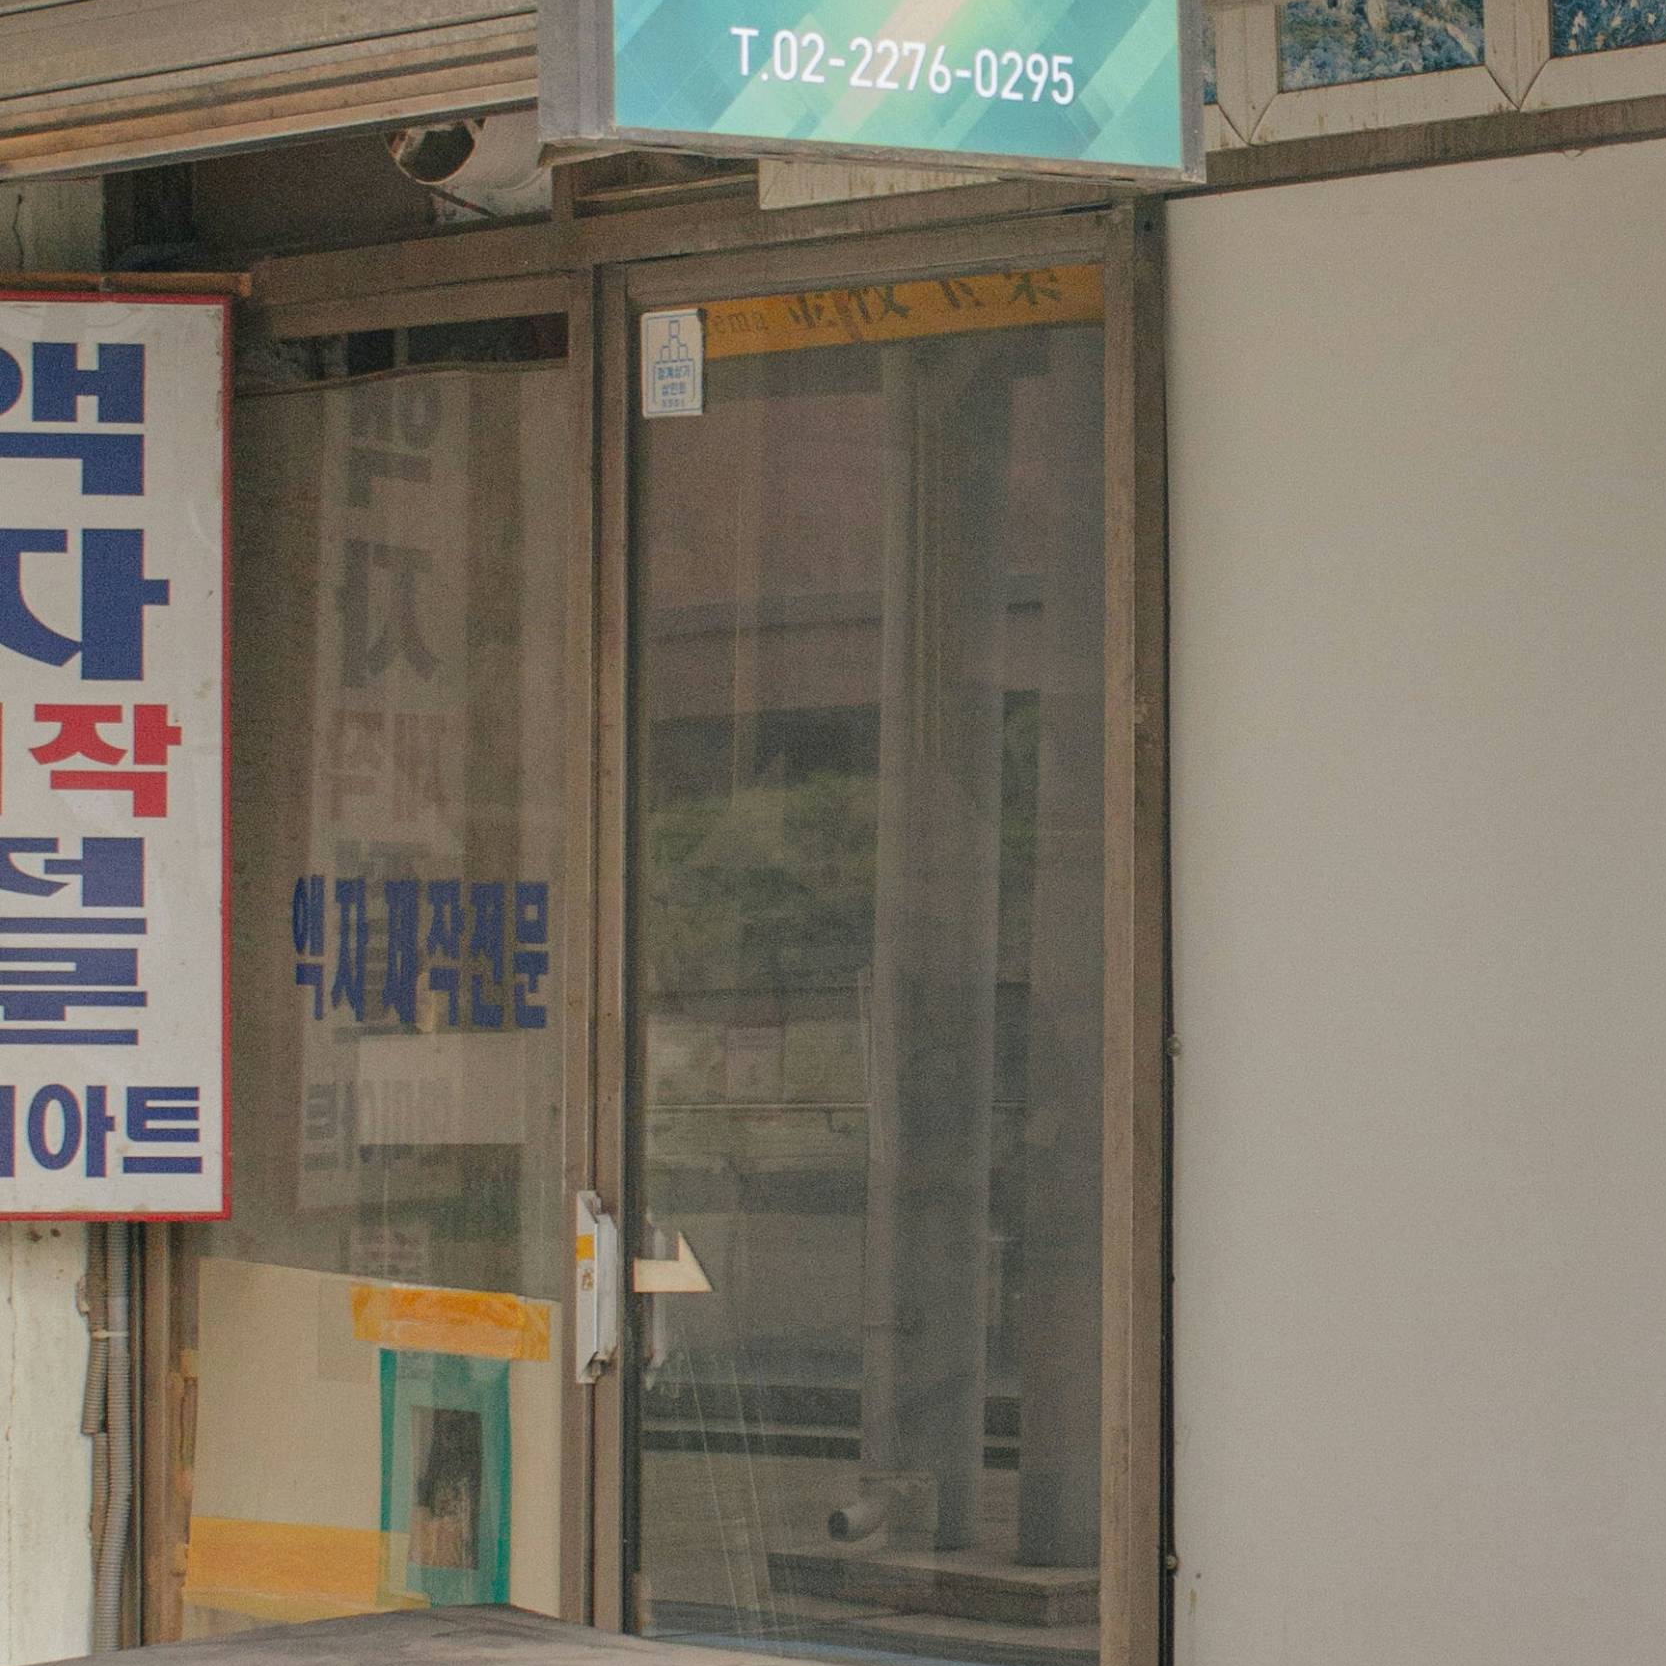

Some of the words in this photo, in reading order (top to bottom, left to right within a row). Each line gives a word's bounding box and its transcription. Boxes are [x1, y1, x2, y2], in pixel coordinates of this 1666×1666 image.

[730, 27, 1075, 106] T.02-2276-0295
[0, 704, 182, 817] 작
[0, 1084, 203, 1178] 아트
